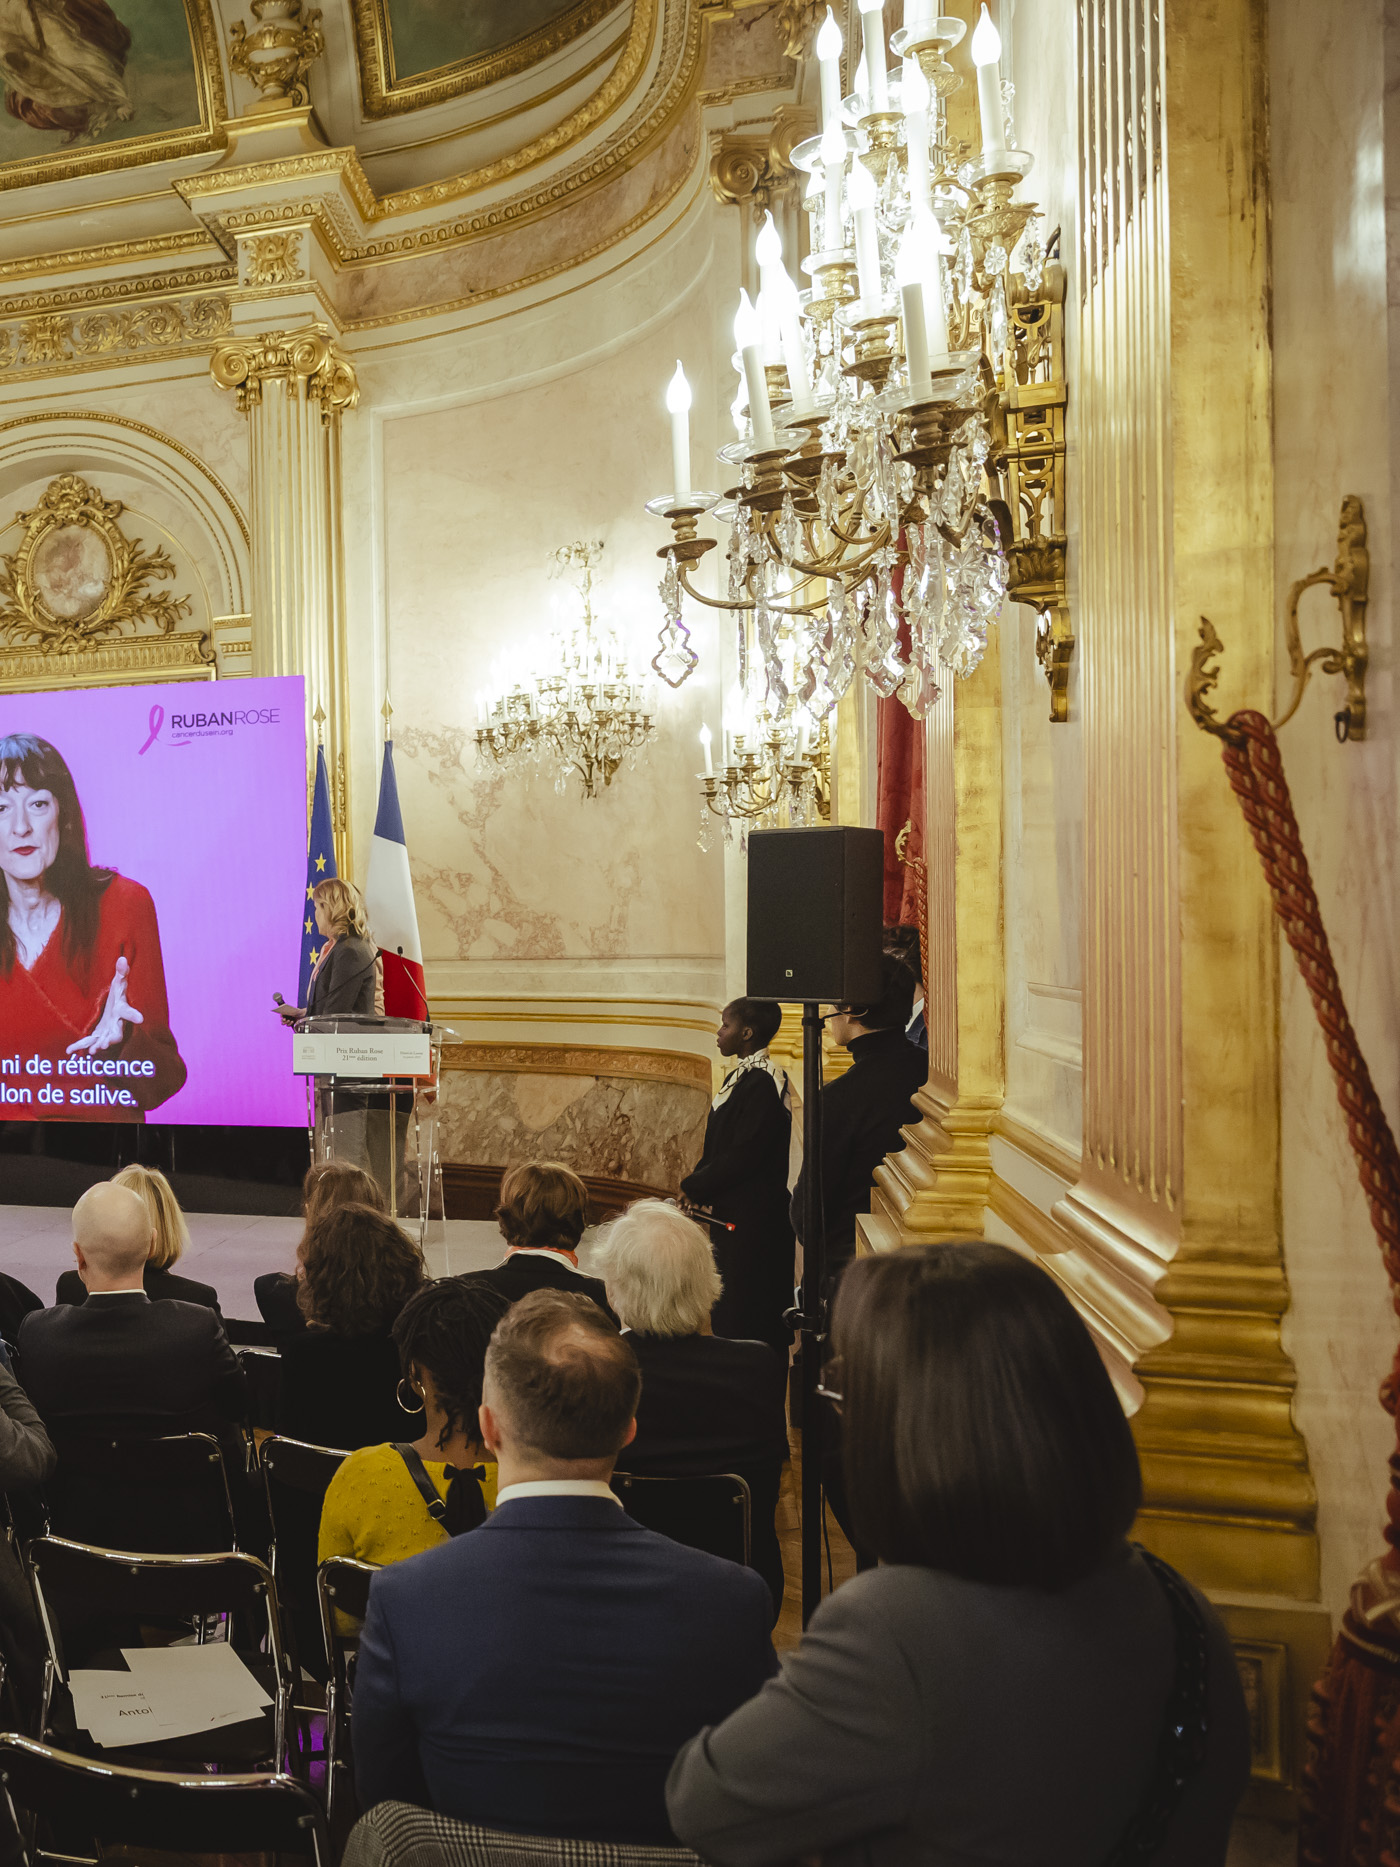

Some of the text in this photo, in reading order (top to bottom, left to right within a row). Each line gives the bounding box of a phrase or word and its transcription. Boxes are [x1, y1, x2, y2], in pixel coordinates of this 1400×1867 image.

[171, 728, 233, 738] cancerdusein.org
[2, 1054, 20, 1074] ni
[25, 1054, 52, 1075] de
[58, 1054, 154, 1076] réticence
[37, 1083, 64, 1104] de
[69, 1084, 138, 1105] salive.
